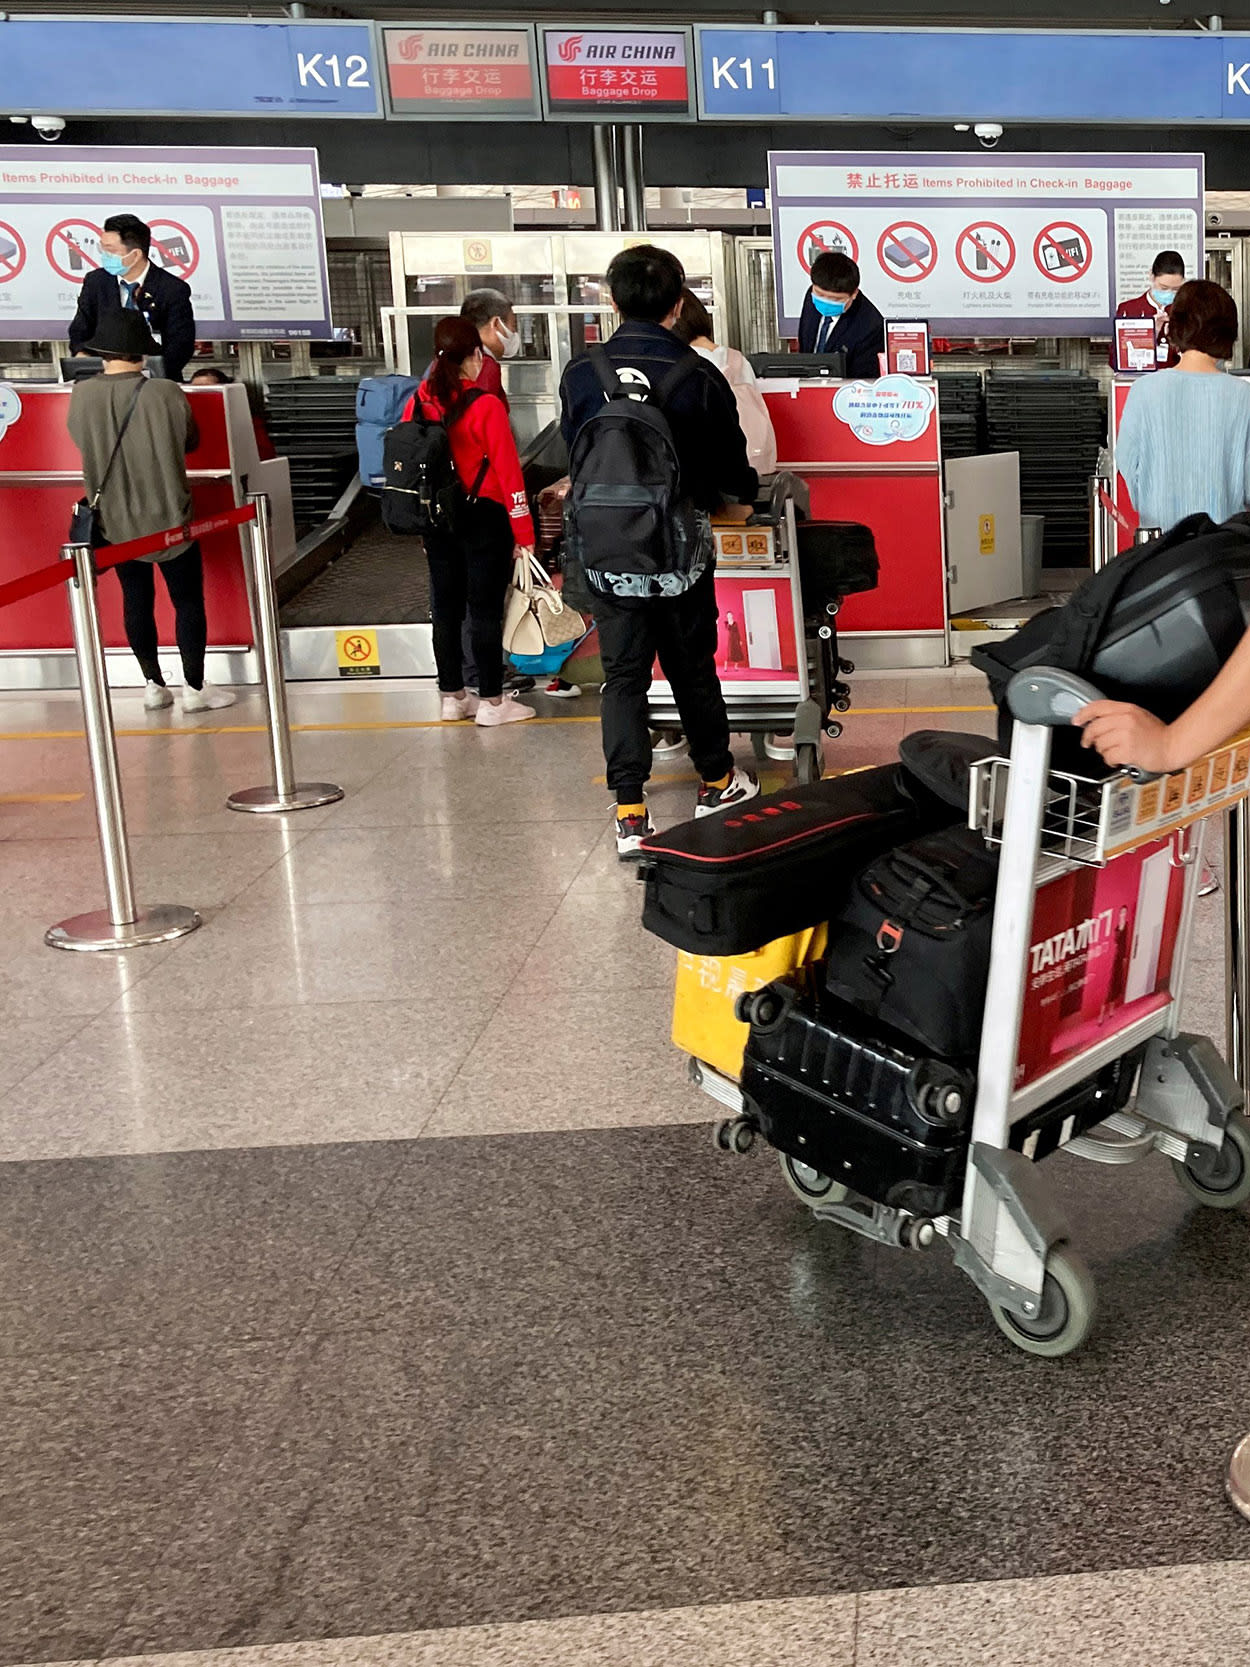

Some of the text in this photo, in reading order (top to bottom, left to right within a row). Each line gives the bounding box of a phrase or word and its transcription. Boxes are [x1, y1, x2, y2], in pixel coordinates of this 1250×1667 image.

[427, 43, 520, 59] AIR CHINA
[586, 45, 676, 60] AIR CHINA
[296, 52, 370, 88] K12
[422, 67, 502, 85] 行李交运
[579, 69, 658, 86] 行李交运
[711, 56, 776, 90] K11
[424, 85, 502, 97] Baggage Drop
[581, 86, 658, 98] Baggage Drop
[2, 172, 240, 188] Items Prohibited in Check-in Baggage
[846, 172, 1134, 192] 禁止托运 Items Prohibited in Check-in Baggage
